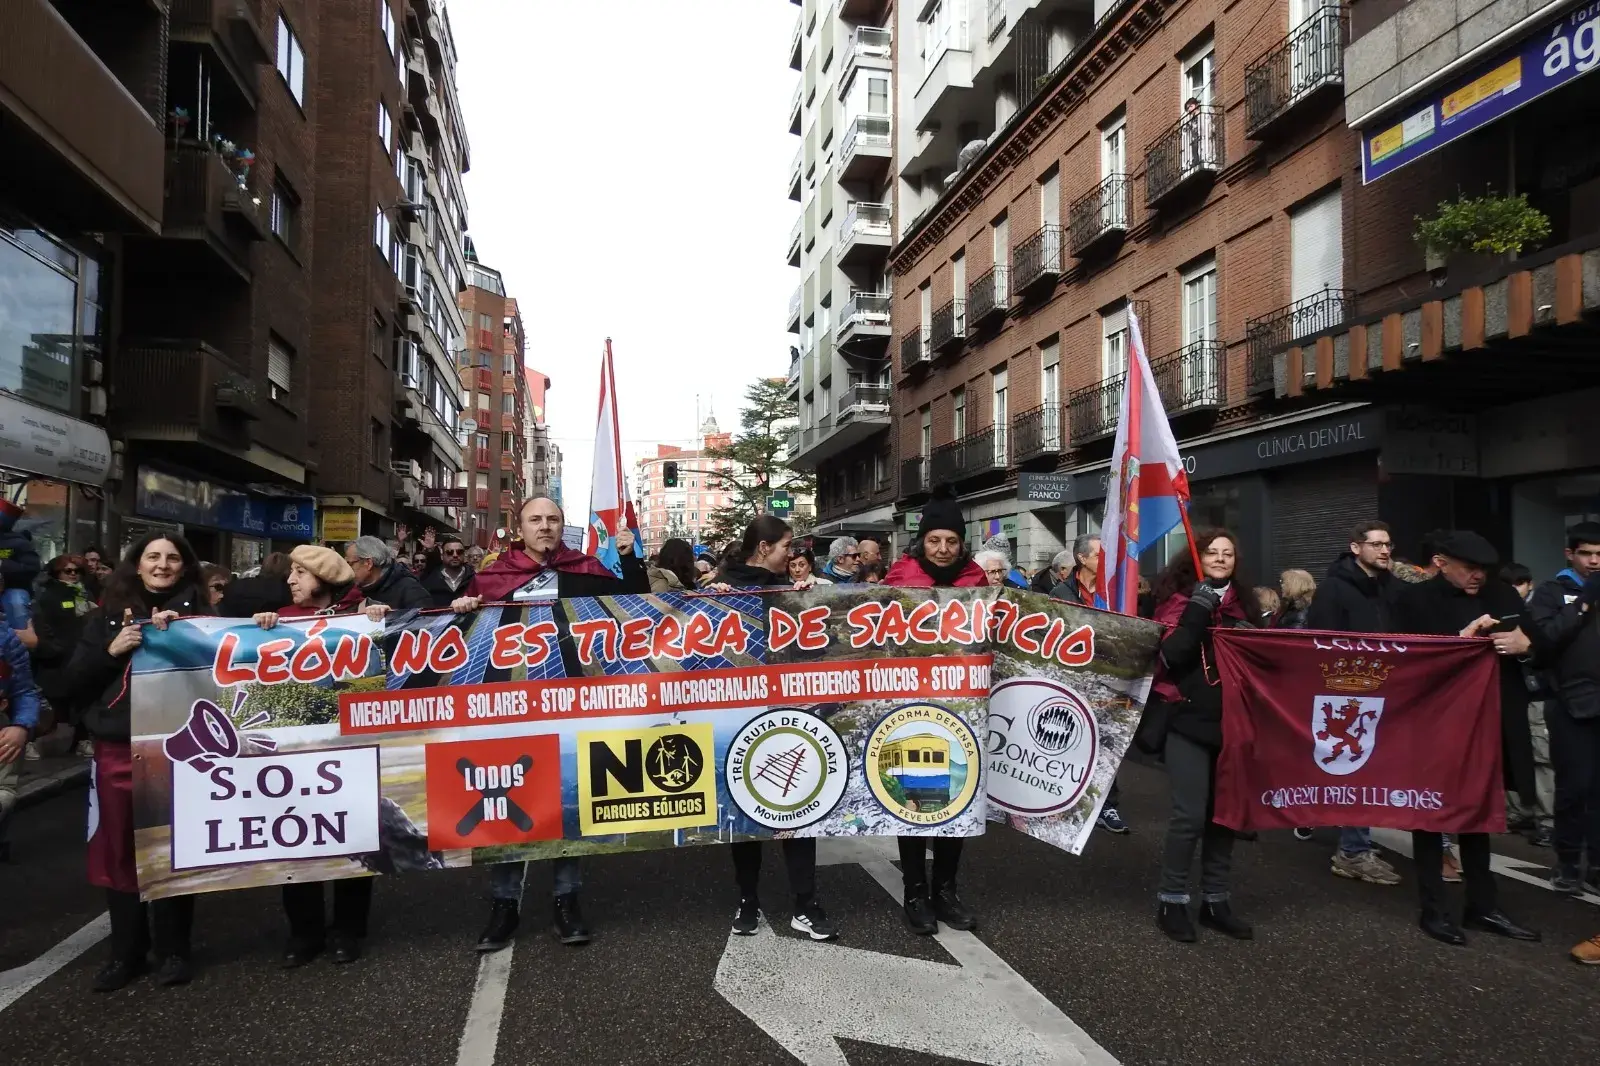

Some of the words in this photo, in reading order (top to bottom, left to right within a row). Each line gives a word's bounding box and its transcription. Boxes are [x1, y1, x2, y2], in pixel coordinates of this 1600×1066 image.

[1257, 434, 1307, 459] CLÍNICA
[1309, 422, 1366, 449] DENTAL
[1028, 482, 1070, 492] GONZÁLEZ
[1028, 491, 1061, 500] FRANCO
[213, 619, 373, 688] LEÓN
[391, 624, 470, 677] NO
[490, 620, 559, 670] ES
[570, 610, 749, 666] TIERRA
[768, 606, 831, 652] DE
[350, 695, 455, 728] MEGAPLANTAS
[467, 690, 529, 719] SOLARES
[541, 687, 577, 713] STOP
[580, 683, 648, 711] CANTERAS
[660, 674, 769, 706] MACROGRANJAS
[780, 670, 861, 698] VERTEDEROS
[863, 662, 919, 694] TÓXICOS
[931, 666, 965, 691] STOP
[733, 749, 744, 783] TREN
[743, 719, 777, 745] RUTA
[781, 717, 799, 727] DE
[802, 721, 819, 737] LA
[818, 734, 838, 775] PLATA
[870, 709, 931, 758] PLATAFORMA
[935, 712, 975, 758] DEFENSA
[210, 760, 343, 801] S.O.S
[464, 763, 524, 792] LODOS
[589, 733, 704, 798] NO
[988, 760, 1009, 775] AÍS
[1010, 767, 1064, 797] LLIONÉS
[483, 796, 508, 821] NO
[595, 800, 650, 821] PARQUES
[653, 797, 703, 816] EÓLICOS
[753, 799, 822, 823] Movimiento
[897, 808, 922, 822] FEVE
[925, 809, 951, 822] LEÓN
[1323, 784, 1358, 806] PAÍS
[1362, 787, 1444, 810] LLIONÉS
[204, 806, 348, 854] LEÓN
